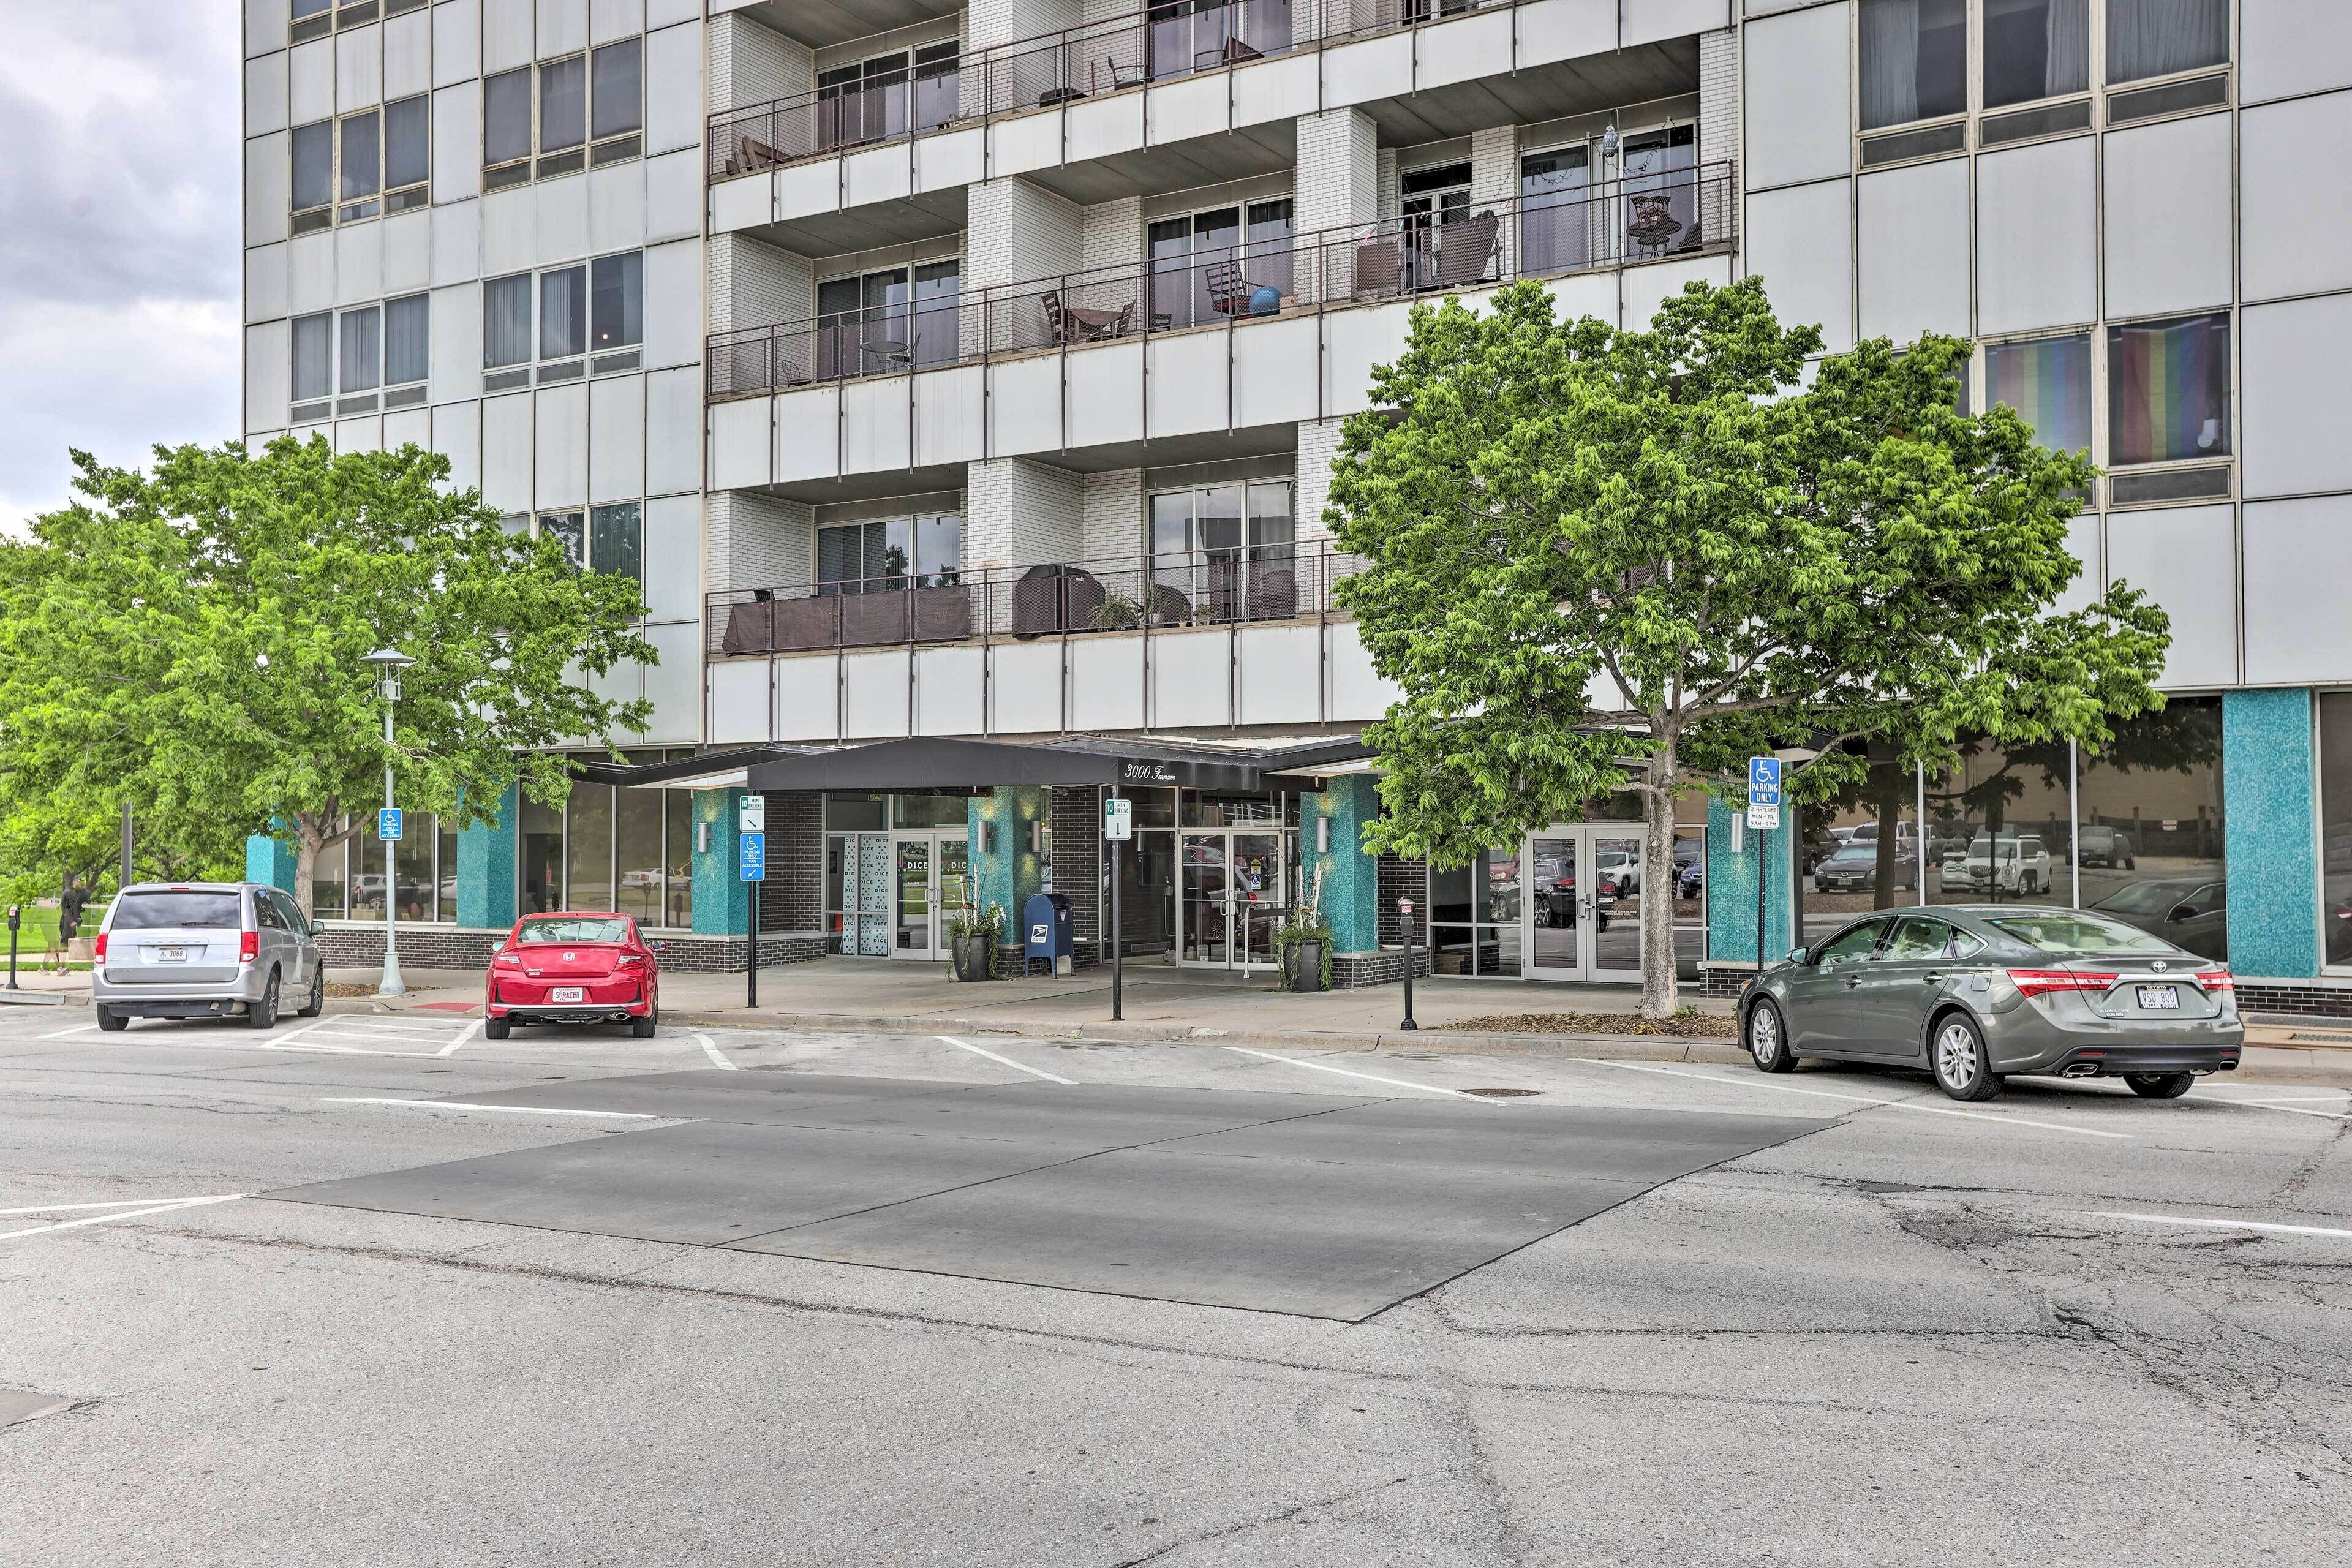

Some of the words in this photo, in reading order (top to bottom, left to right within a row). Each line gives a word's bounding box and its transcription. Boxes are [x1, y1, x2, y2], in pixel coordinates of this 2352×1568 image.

[1125, 764, 1151, 779] 3000
[1152, 766, 1176, 780] Farnam
[1752, 783, 1778, 793] PARKING
[1756, 793, 1773, 802] ONLY
[1107, 804, 1114, 812] 10
[2143, 992, 2156, 1003] VSD
[2161, 992, 2174, 1003] 800
